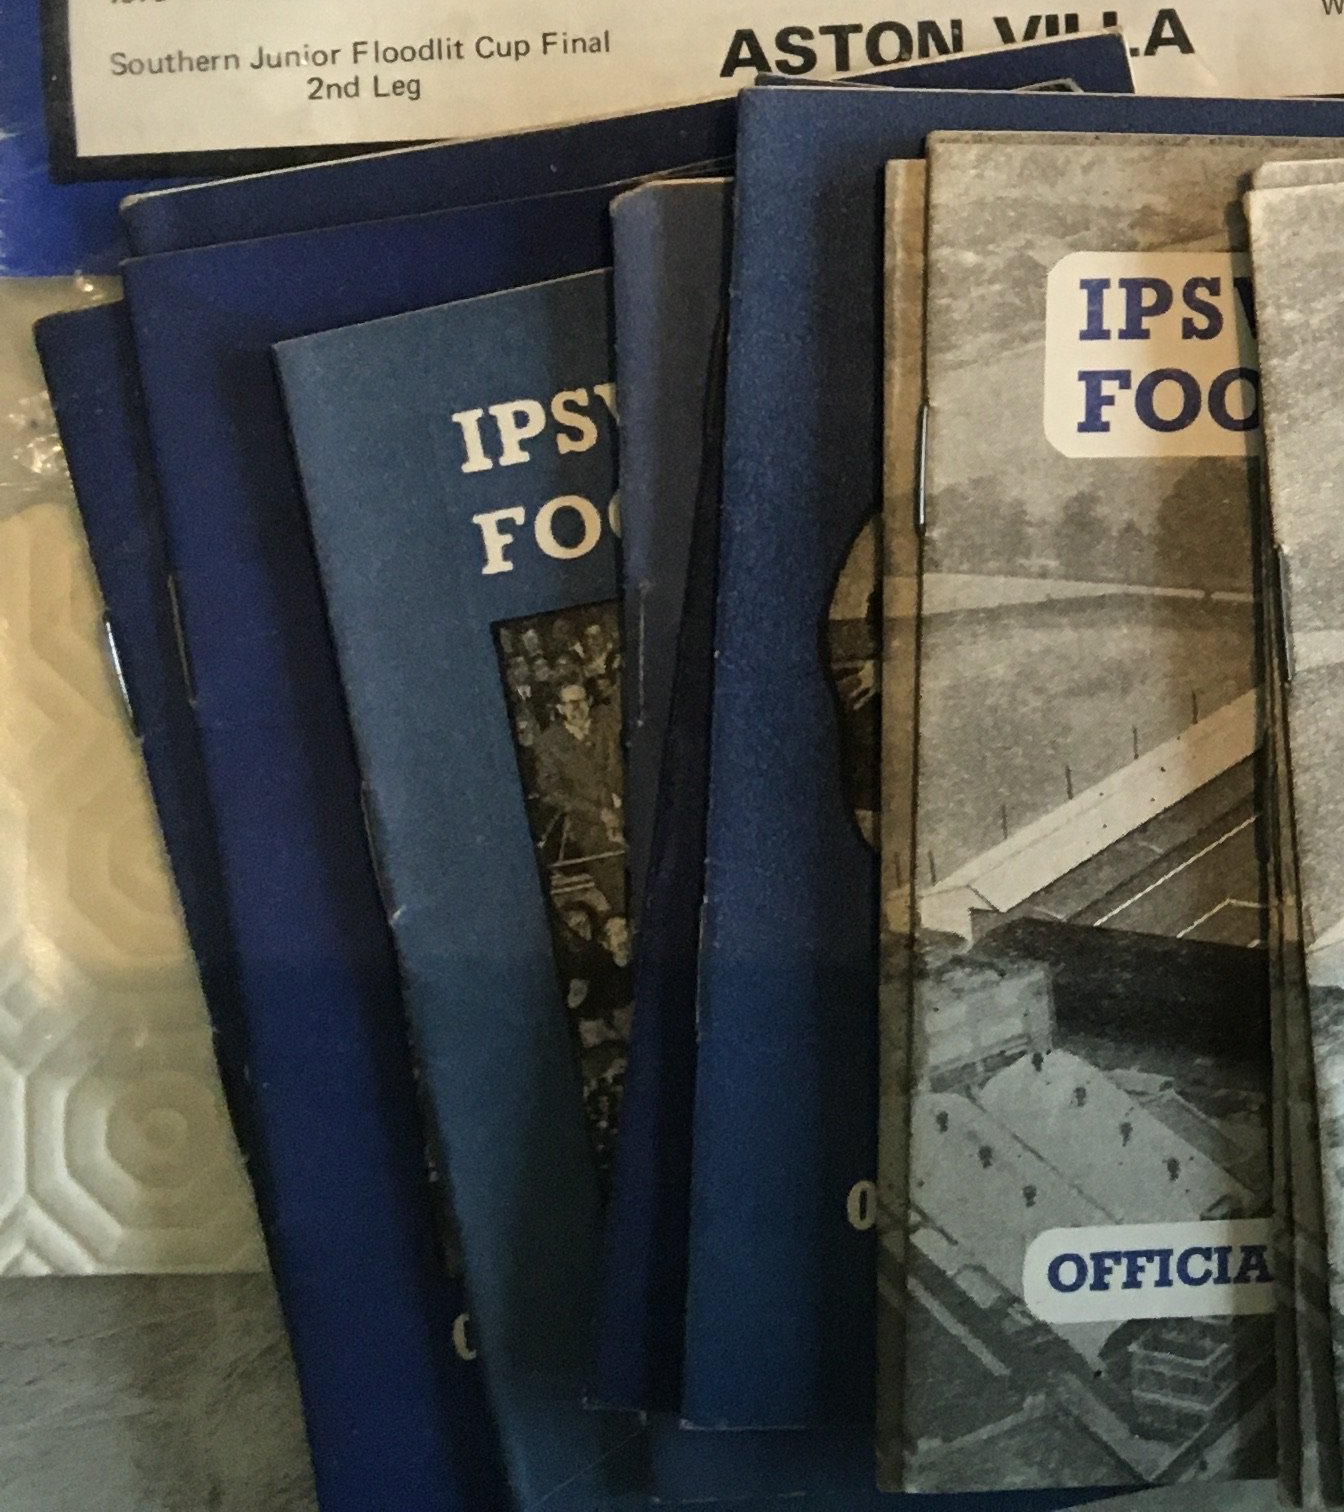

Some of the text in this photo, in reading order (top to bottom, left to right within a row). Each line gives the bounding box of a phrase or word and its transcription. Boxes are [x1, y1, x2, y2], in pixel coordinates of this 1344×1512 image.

[110, 30, 611, 76] Southern Junior Floodlit Cup Final
[719, 18, 963, 77] ASTON
[306, 71, 422, 101] 2nd Leg
[472, 489, 621, 575] FO
